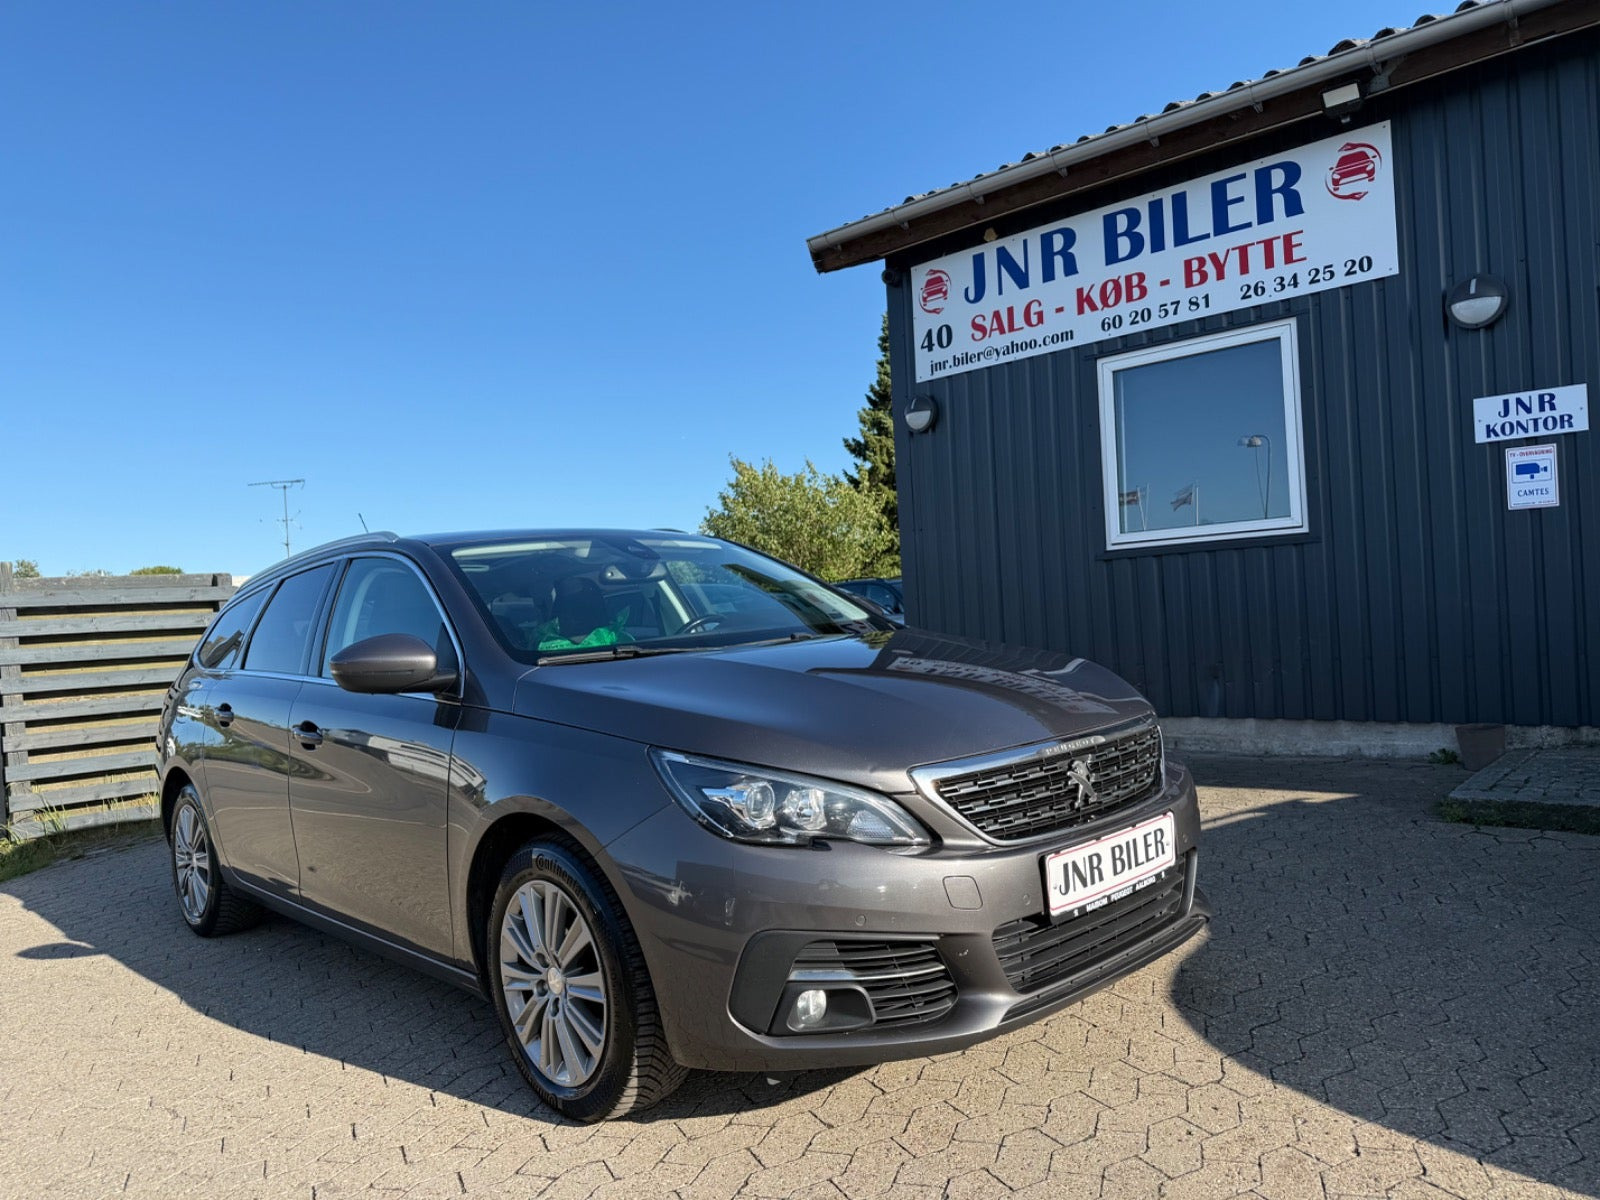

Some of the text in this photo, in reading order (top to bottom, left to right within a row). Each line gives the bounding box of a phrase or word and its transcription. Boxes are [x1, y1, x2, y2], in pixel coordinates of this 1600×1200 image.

[964, 160, 1305, 304] JNR BILER
[971, 299, 1044, 342] SALG
[1075, 271, 1148, 316] KØB
[1183, 230, 1307, 288] BYTTE
[1240, 255, 1373, 300] 26 34 25 20
[1101, 293, 1210, 332] 60 20 57 81
[920, 324, 953, 353] 40
[930, 330, 1074, 375] jnr.biler@yahoo.com
[1485, 413, 1574, 439] KONTOR
[1498, 392, 1557, 418] JNR
[1059, 827, 1166, 896] JNR BILER
